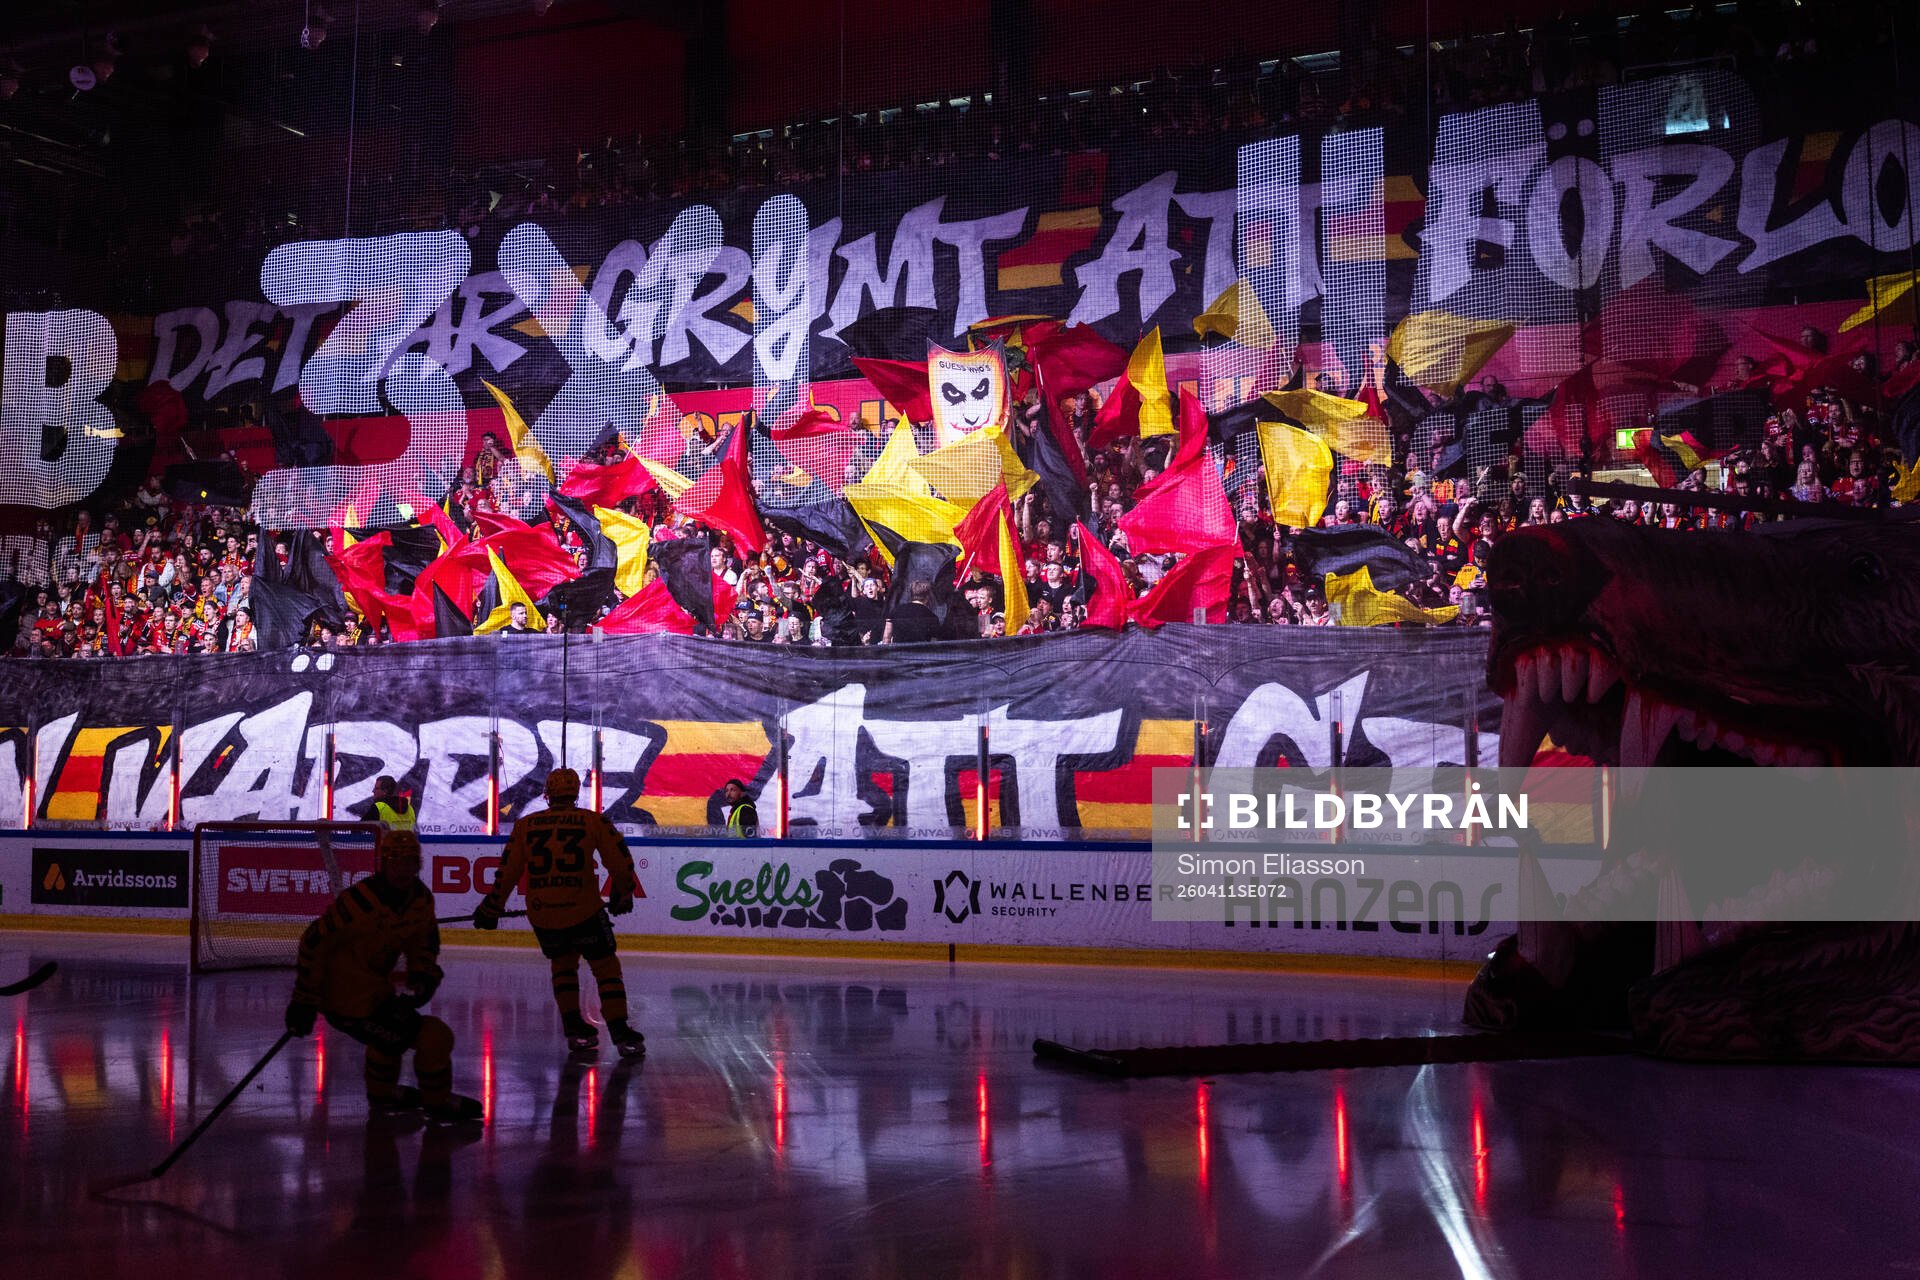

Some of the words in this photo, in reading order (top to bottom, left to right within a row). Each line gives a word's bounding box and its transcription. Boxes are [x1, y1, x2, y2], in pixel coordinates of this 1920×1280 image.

[148, 300, 341, 401] DET
[585, 194, 1030, 381] GRYMT
[1064, 170, 1357, 329] ATT
[1416, 117, 1920, 303] FÖRLO
[105, 652, 653, 828] VÄRRE
[752, 683, 1125, 838] ATT
[113, 821, 141, 829] NYAB
[526, 828, 587, 875] 33
[72, 867, 178, 890] Arvidssons
[670, 860, 821, 922] Snells
[991, 906, 1057, 918] SECURITY
